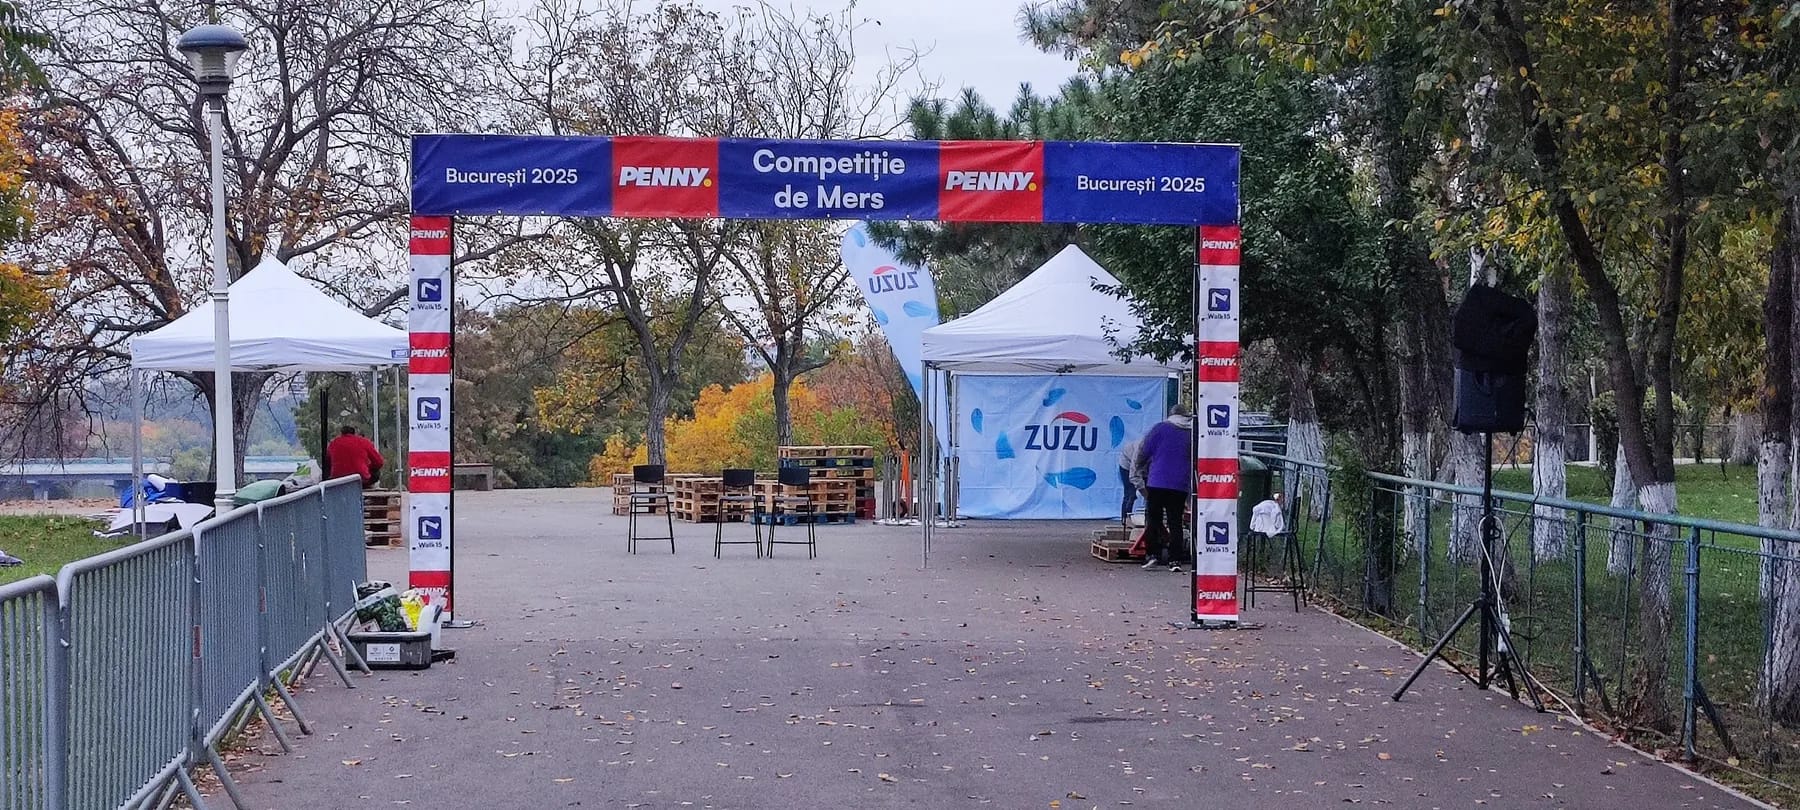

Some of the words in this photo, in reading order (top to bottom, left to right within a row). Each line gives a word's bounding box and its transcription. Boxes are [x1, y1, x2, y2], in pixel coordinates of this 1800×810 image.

[753, 149, 905, 181] Competiție
[446, 168, 526, 187] București
[532, 169, 577, 184] 2025
[1077, 175, 1155, 195] București
[1161, 177, 1205, 192] 2025
[774, 185, 808, 208] de
[817, 186, 884, 209] Mers
[1025, 424, 1098, 451] ZUZU
